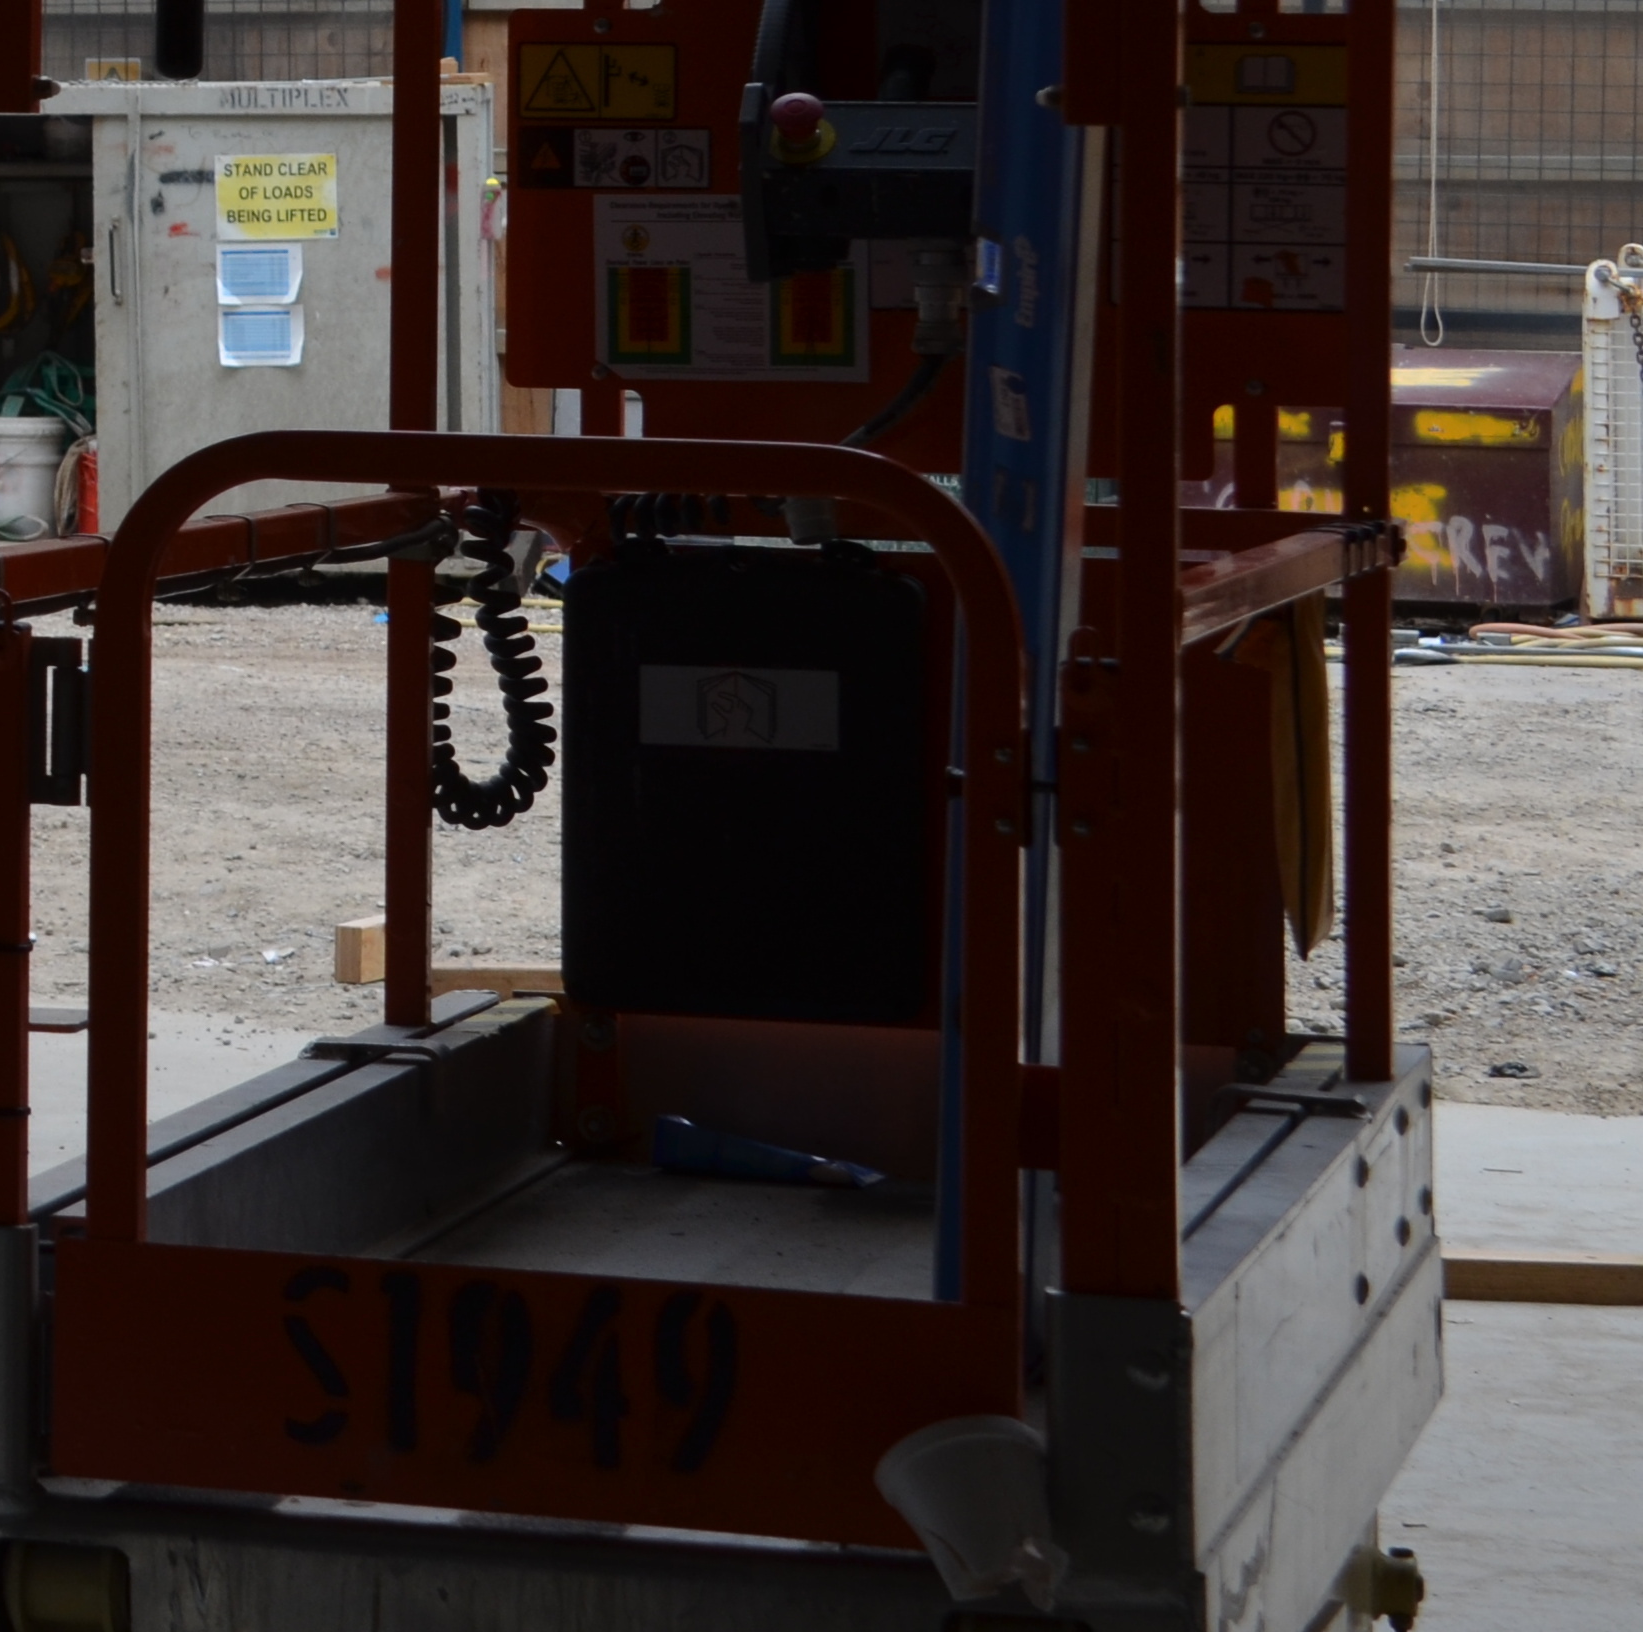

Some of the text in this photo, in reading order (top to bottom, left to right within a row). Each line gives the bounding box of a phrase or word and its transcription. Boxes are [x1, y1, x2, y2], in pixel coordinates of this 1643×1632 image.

[218, 86, 350, 109] MULTIPLEX
[850, 126, 957, 154] JLG
[224, 162, 328, 177] STAND CLEAR
[238, 185, 313, 200] OF LOADS
[226, 208, 327, 223] BEING LIFTED
[283, 1264, 740, 1475] S1949
